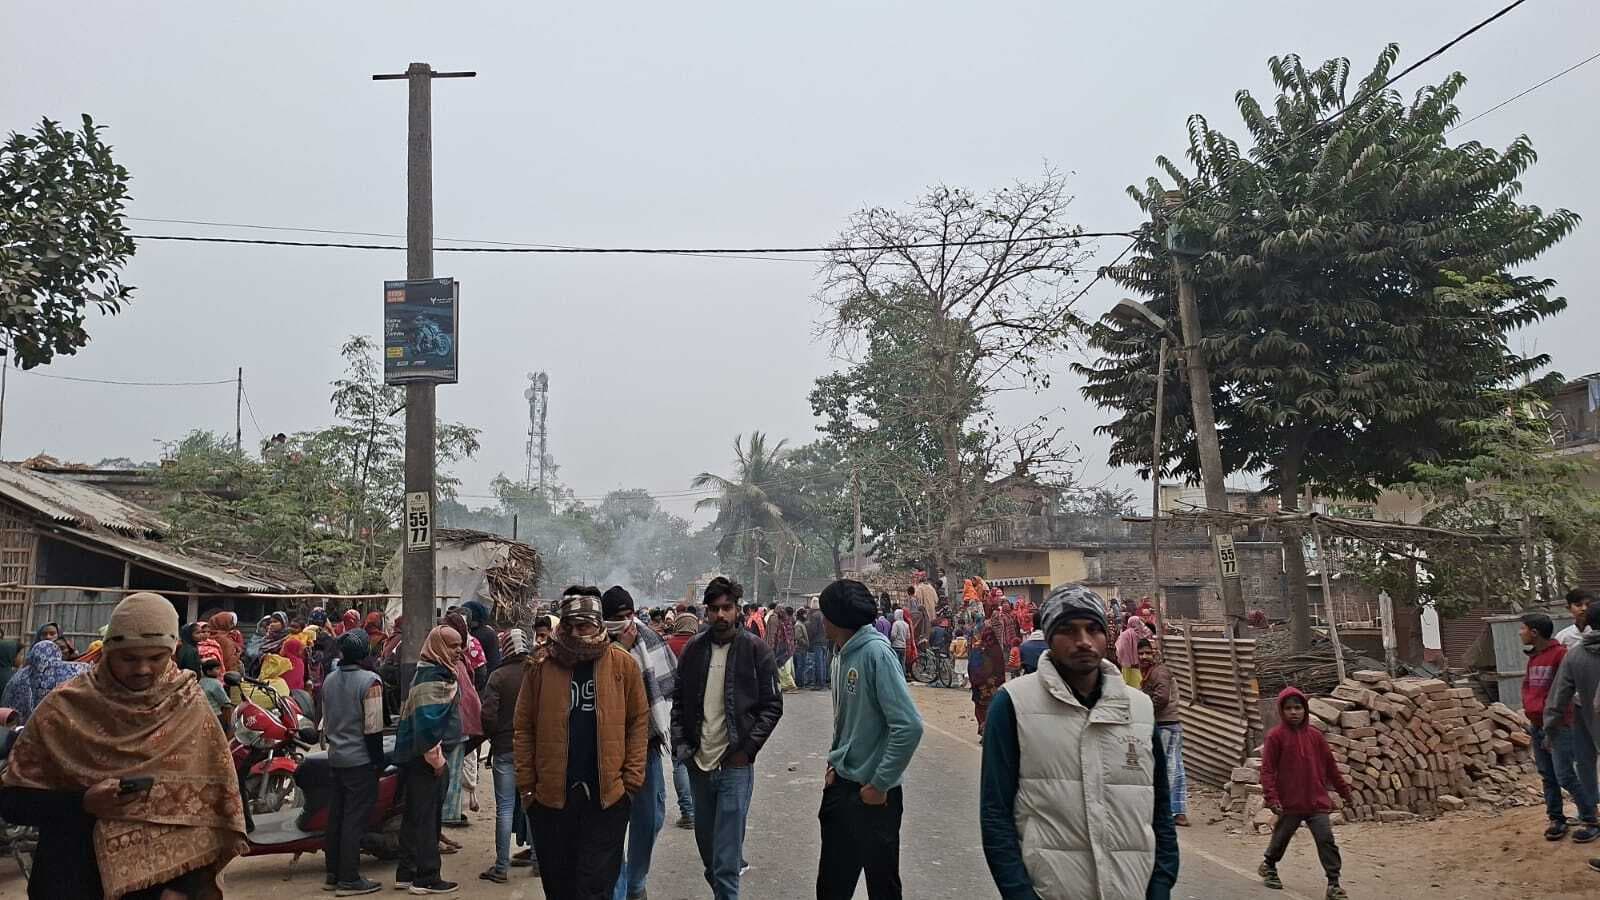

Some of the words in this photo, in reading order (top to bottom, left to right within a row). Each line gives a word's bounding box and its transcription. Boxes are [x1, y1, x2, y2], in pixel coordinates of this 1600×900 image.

[410, 512, 428, 527] 55
[411, 528, 427, 543] 77
[1221, 549, 1234, 561] 55
[1224, 561, 1235, 572] 77
